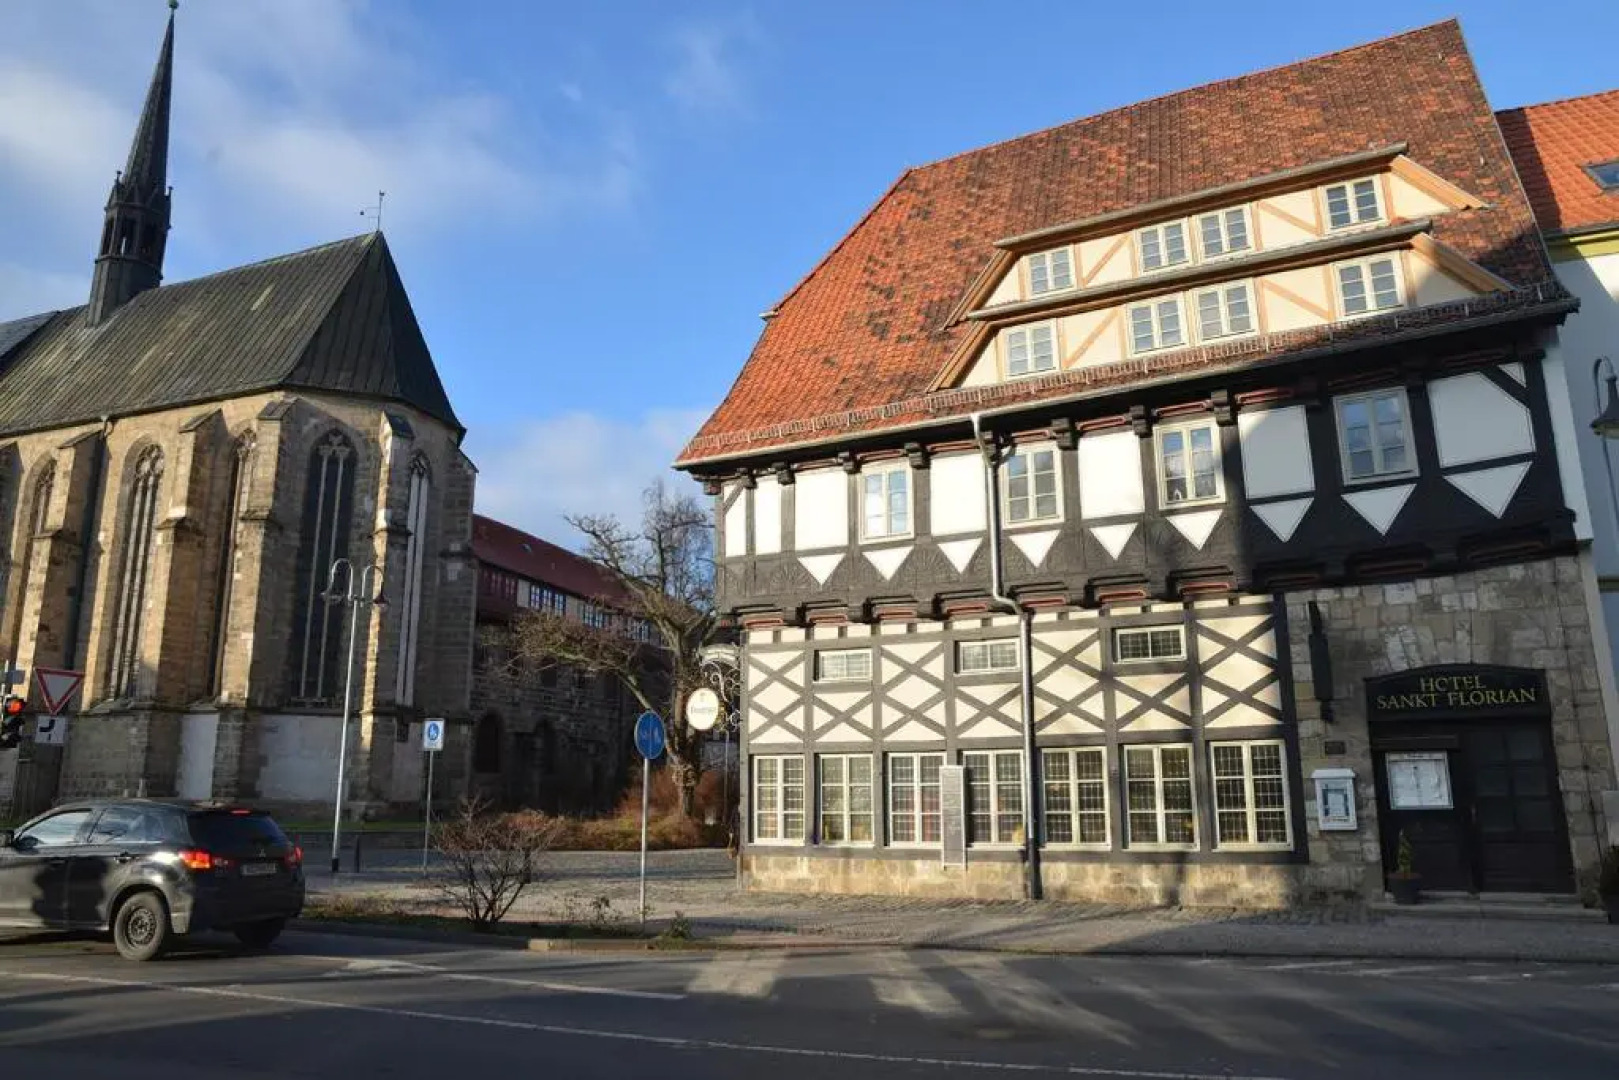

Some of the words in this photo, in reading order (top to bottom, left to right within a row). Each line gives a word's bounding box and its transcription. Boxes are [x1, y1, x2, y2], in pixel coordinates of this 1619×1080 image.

[1420, 675, 1486, 692] HOTEL
[1376, 693, 1437, 710] SANKT
[1448, 687, 1536, 706] FLORIAN
